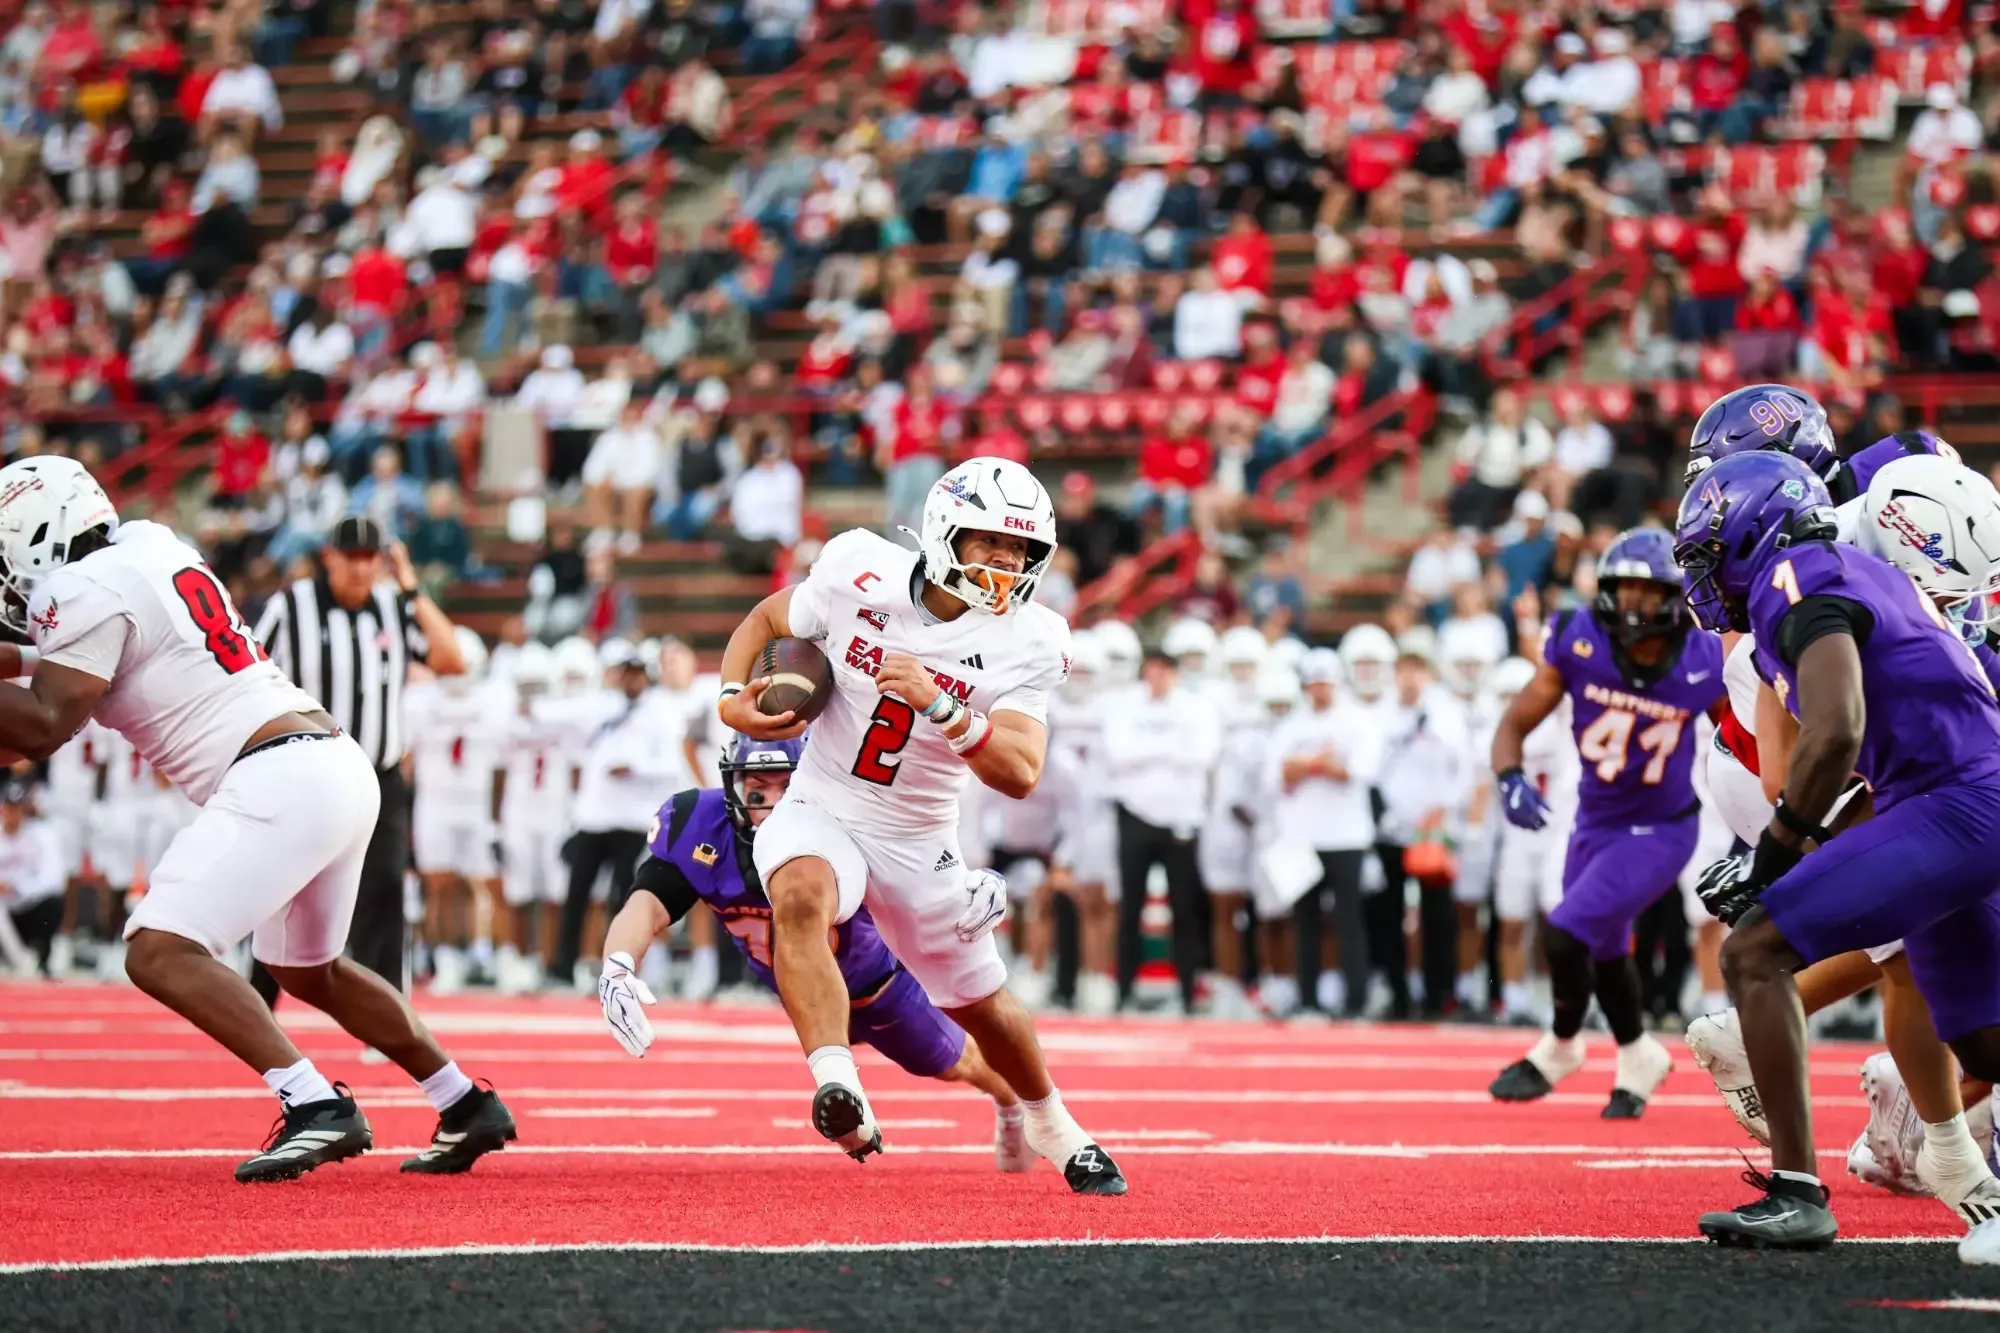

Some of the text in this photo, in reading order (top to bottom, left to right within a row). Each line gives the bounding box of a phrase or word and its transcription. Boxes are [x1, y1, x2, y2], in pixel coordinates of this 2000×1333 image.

[1749, 391, 1803, 436] 90
[1004, 516, 1036, 533] EKG
[853, 571, 882, 593] C
[1771, 559, 1802, 605] 1
[172, 563, 269, 675] 8
[869, 611, 890, 625] SKY
[847, 635, 977, 700] EARN
[851, 694, 916, 787] 2
[1579, 708, 1683, 785] 41
